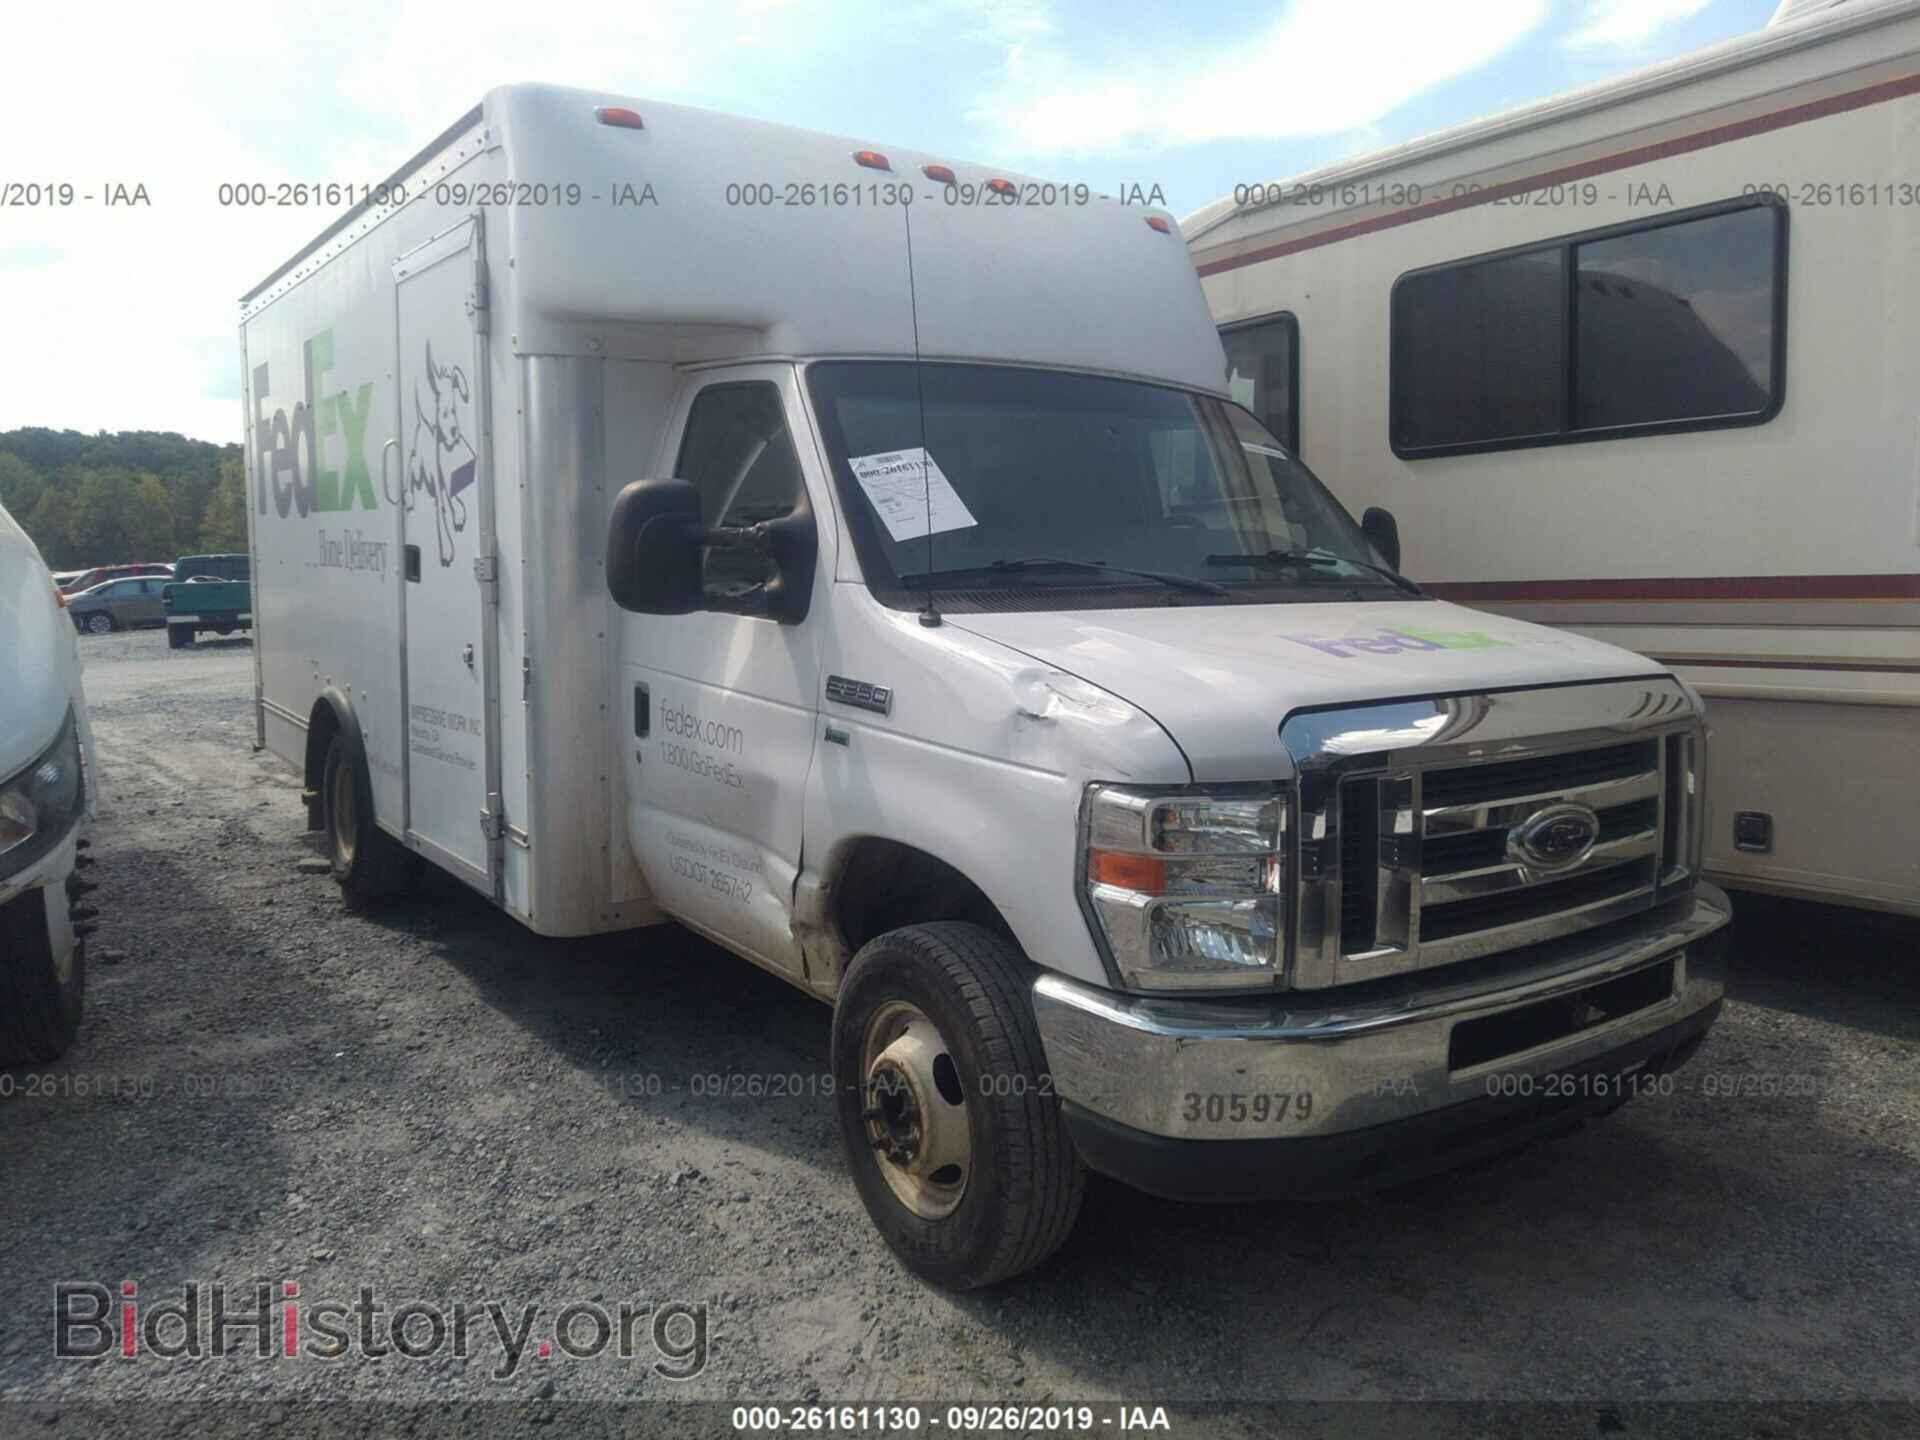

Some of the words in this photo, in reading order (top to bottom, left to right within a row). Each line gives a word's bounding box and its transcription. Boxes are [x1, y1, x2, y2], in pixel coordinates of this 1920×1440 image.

[252, 327, 379, 519] FedEx
[659, 696, 744, 754] fedex.com
[1181, 1091, 1313, 1123] 305979
